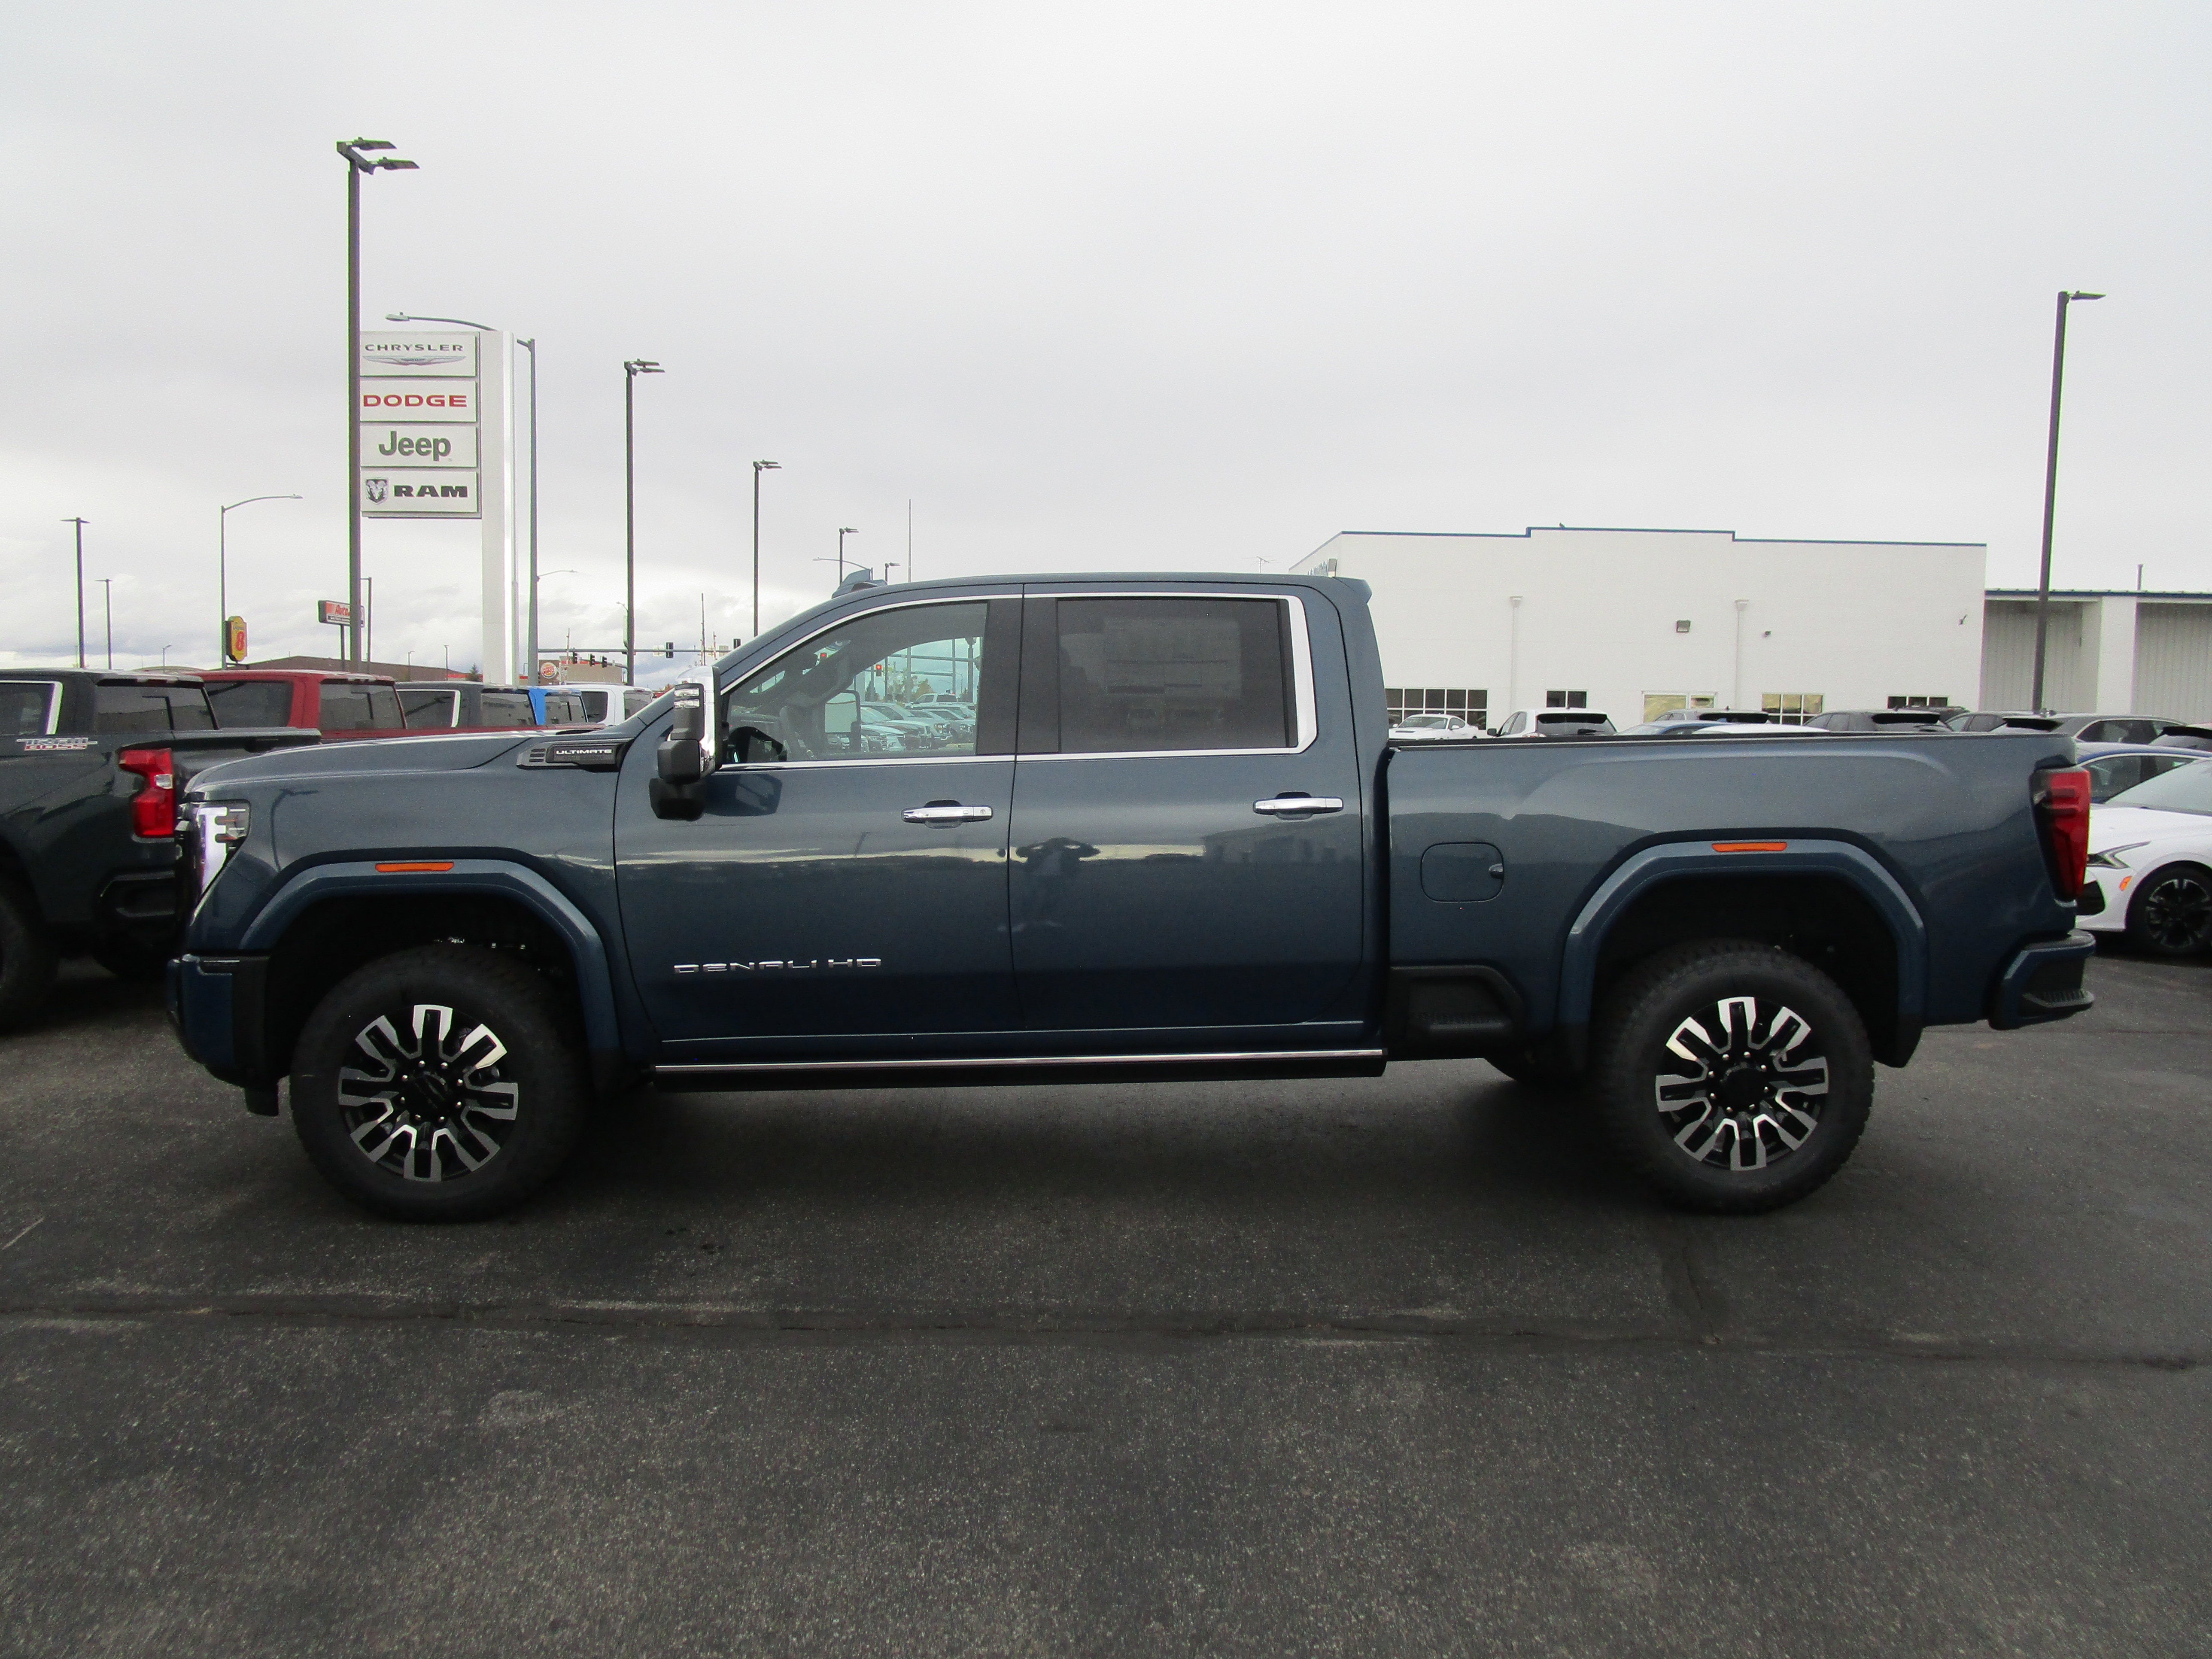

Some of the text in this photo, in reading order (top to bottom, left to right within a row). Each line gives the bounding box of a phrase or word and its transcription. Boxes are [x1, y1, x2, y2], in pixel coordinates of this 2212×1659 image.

[363, 395, 467, 407] DODGE
[379, 431, 451, 462] Jeep
[394, 485, 468, 498] RAM
[16, 737, 98, 745] TRAIL
[674, 958, 881, 973] DENALI HD
